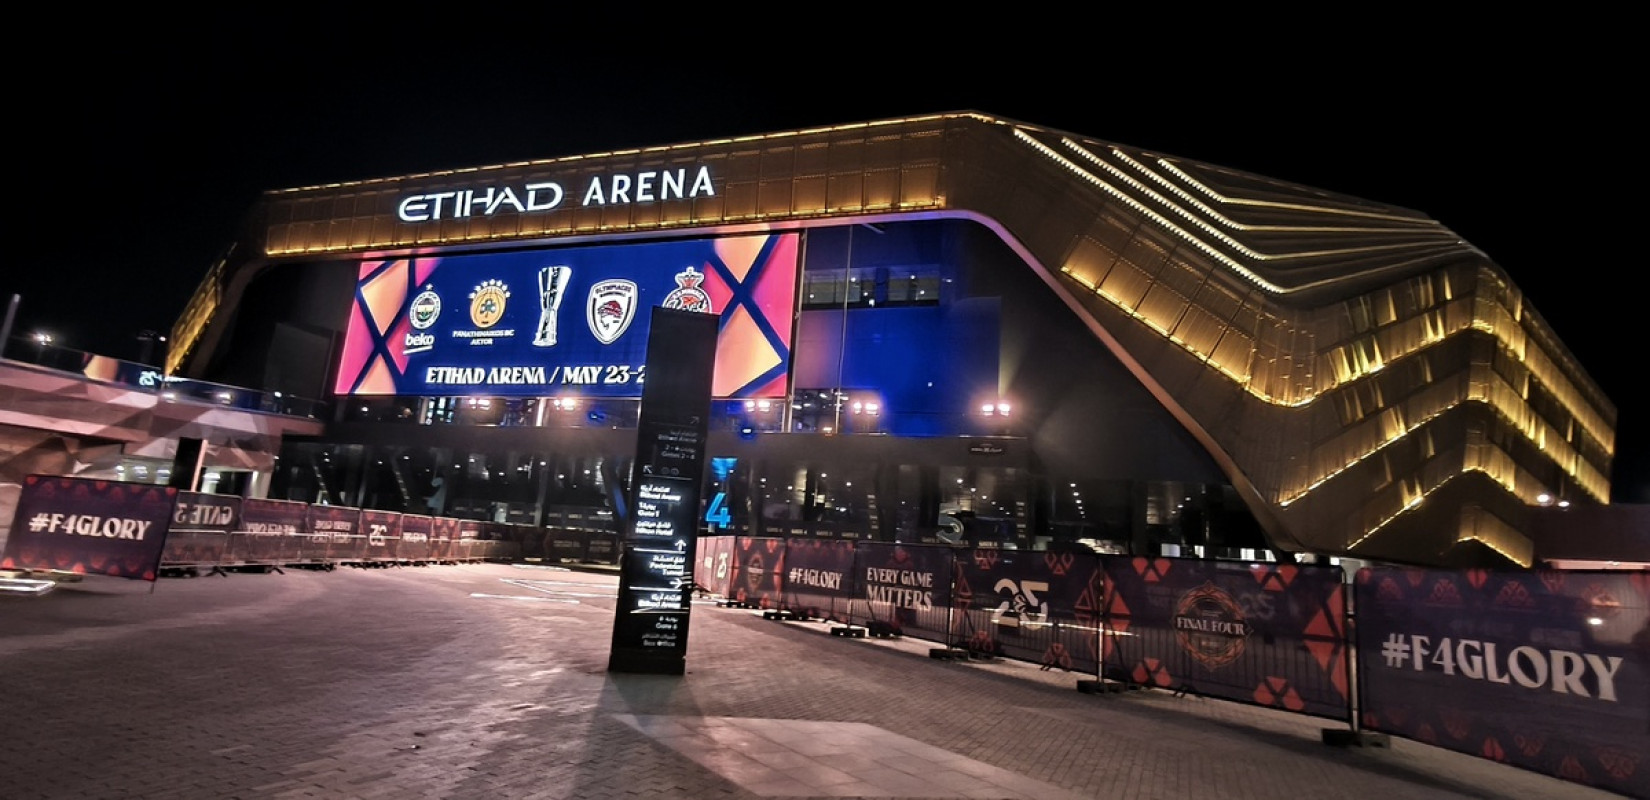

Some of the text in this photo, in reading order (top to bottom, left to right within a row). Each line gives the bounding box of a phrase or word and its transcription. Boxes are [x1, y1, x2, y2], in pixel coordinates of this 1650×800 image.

[398, 165, 715, 222] ETIHAD ARENA
[405, 333, 435, 346] beko
[425, 366, 485, 384] ETIHAD
[487, 366, 546, 385] ARENA
[561, 366, 602, 384] MAY
[705, 492, 731, 529] 4
[28, 512, 152, 541] #F4GLORY
[789, 567, 843, 591] #F4GLORY
[867, 567, 933, 588] EVERY GAME
[866, 584, 933, 612] MATTERS
[1176, 616, 1245, 636] FINAL FOUR
[1381, 632, 1624, 702] #F4GLORY
